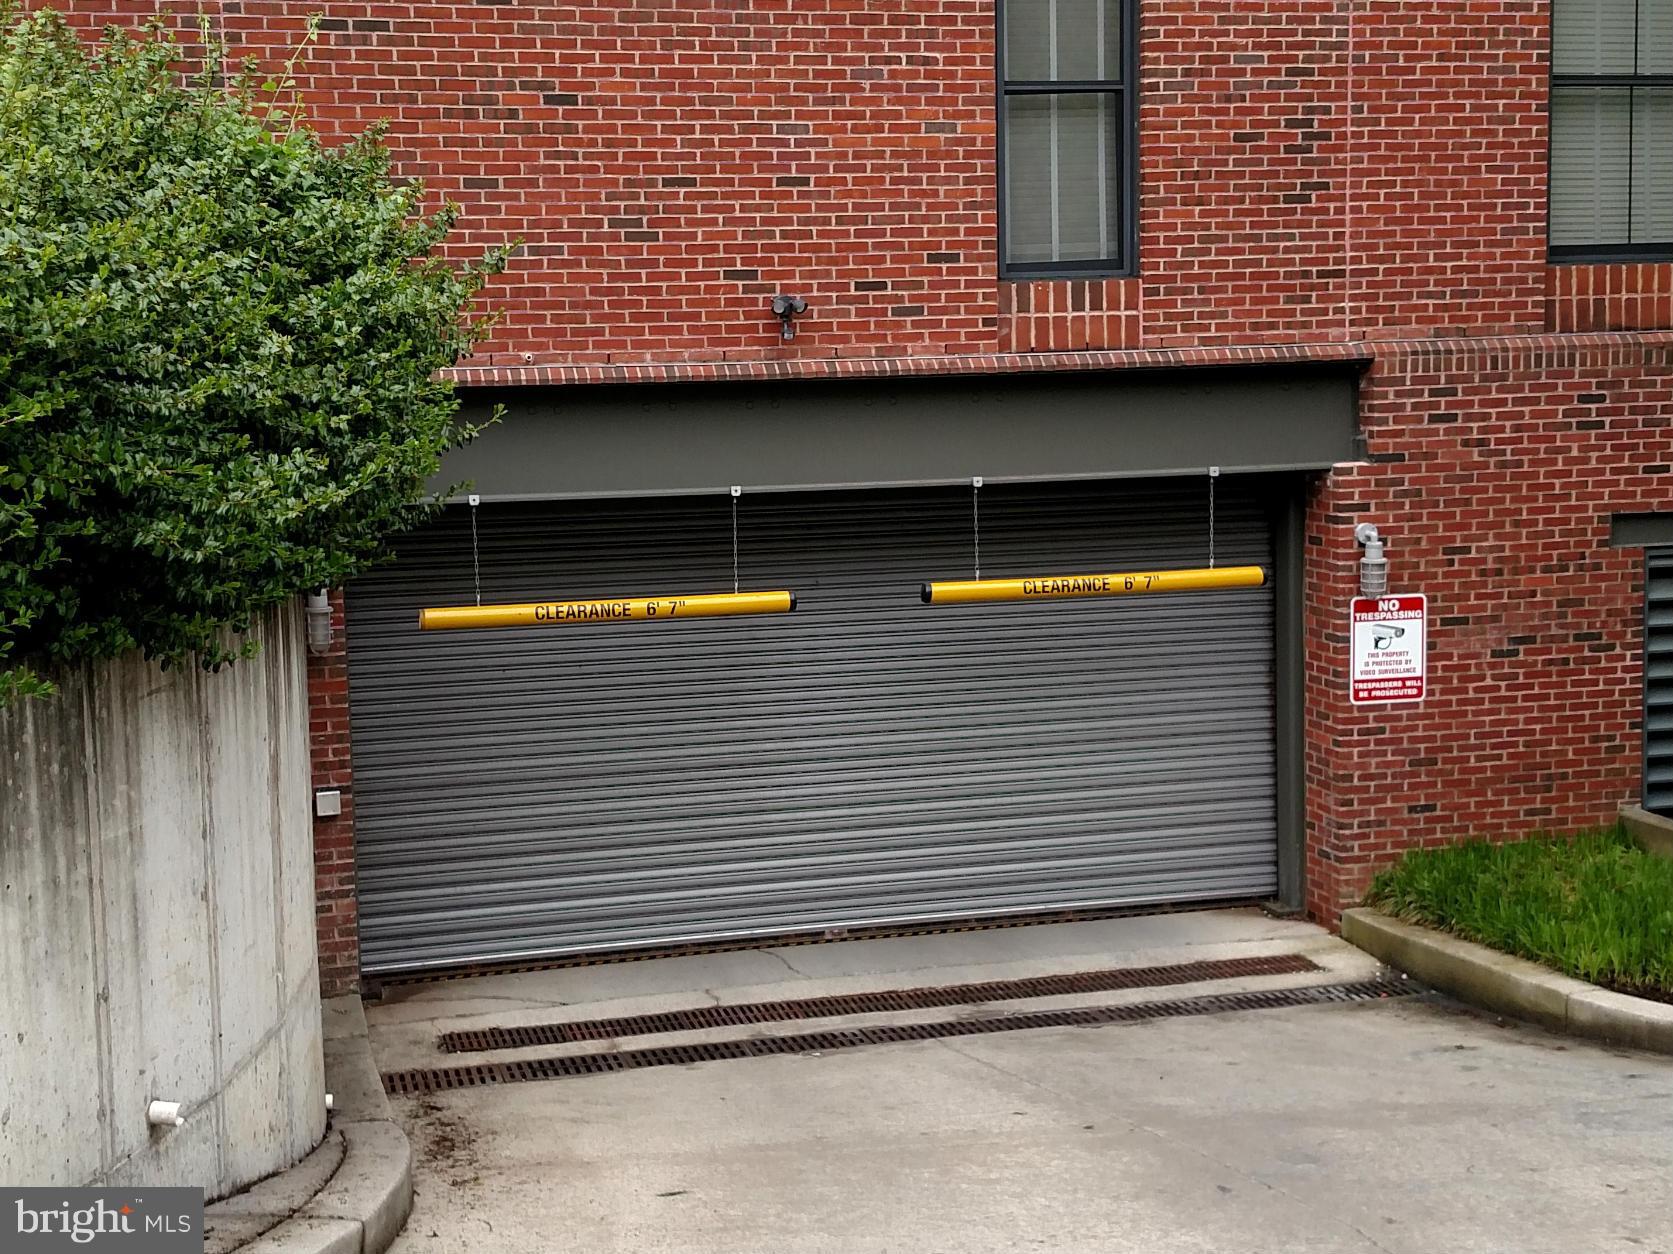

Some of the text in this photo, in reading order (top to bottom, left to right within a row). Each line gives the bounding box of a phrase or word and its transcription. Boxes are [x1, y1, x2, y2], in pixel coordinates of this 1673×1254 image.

[1023, 575, 1161, 596] CLEARANCE 6' 7"
[1378, 599, 1400, 612] NO
[534, 600, 687, 621] CLEARANCE 6' 7"
[1355, 610, 1422, 621] TRESPASSING
[1367, 650, 1409, 659] THIS PROPERTY
[1371, 659, 1403, 667] PROTECTED
[1378, 667, 1417, 675] SURVEILLANCE
[1354, 681, 1402, 689] TRESPASSERS
[1371, 688, 1418, 697] PROSECUTED
